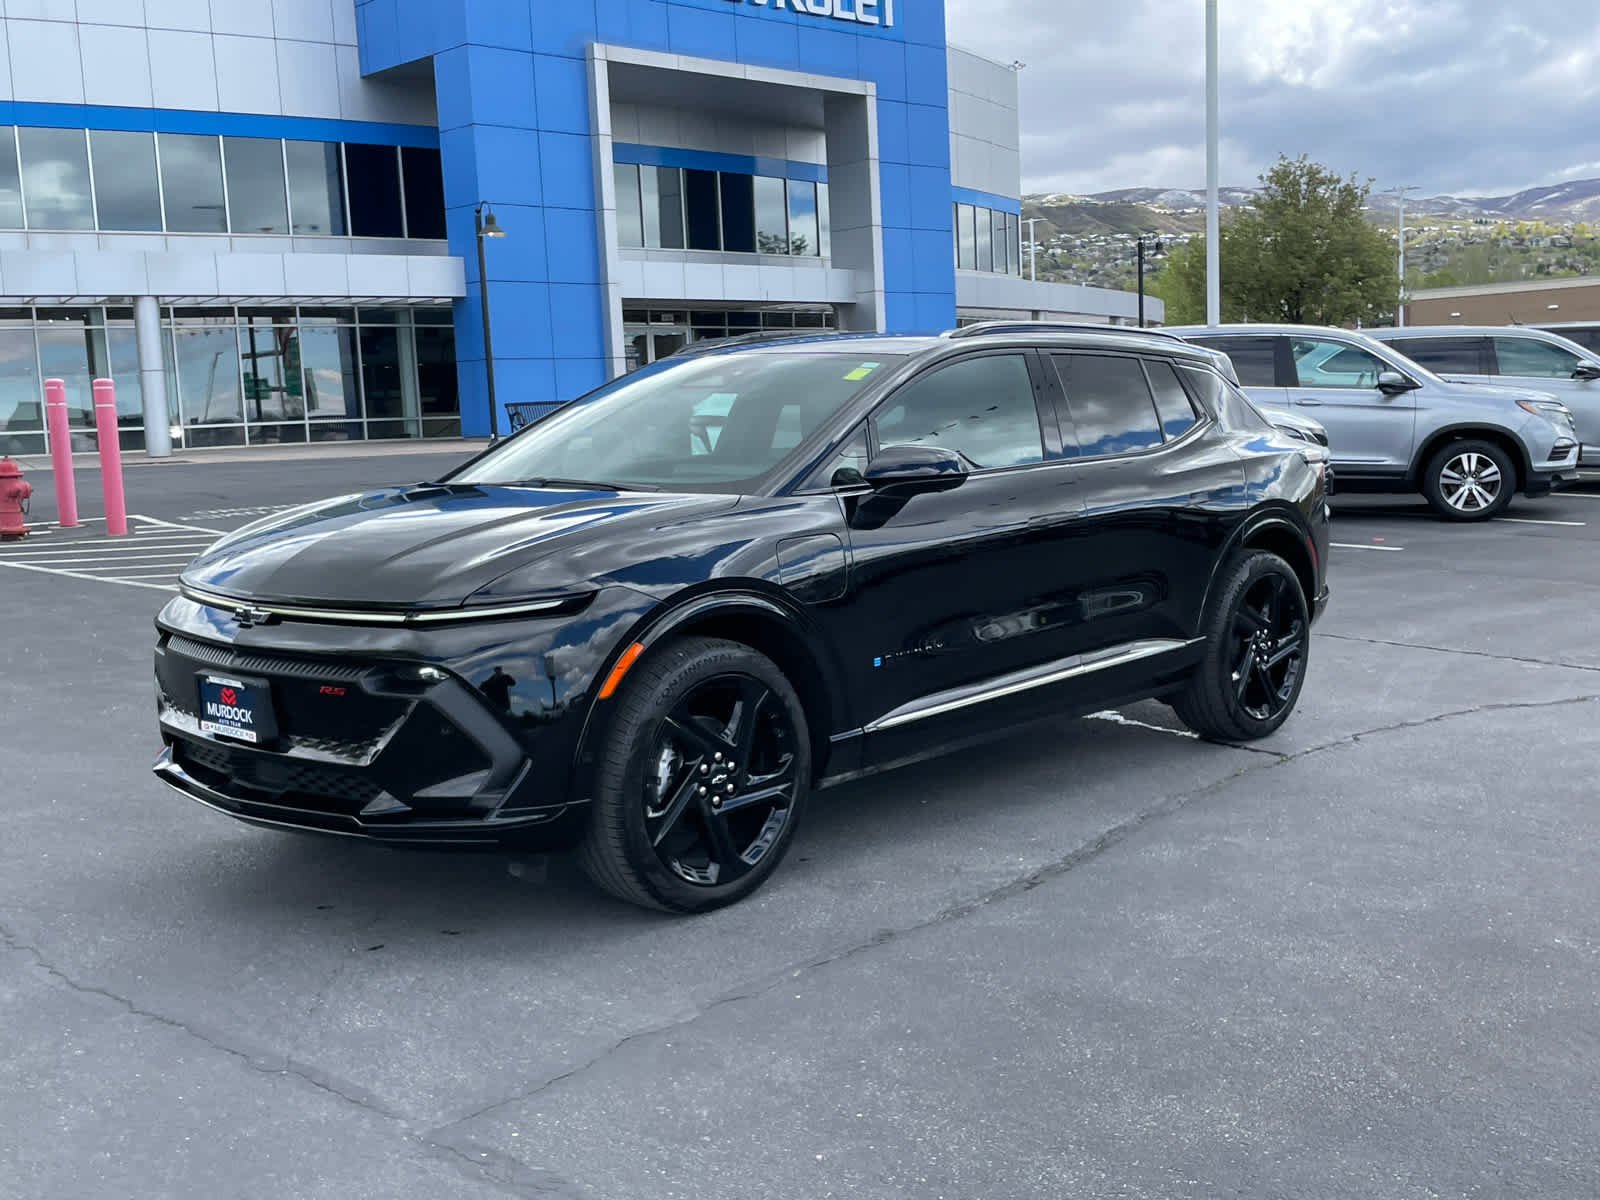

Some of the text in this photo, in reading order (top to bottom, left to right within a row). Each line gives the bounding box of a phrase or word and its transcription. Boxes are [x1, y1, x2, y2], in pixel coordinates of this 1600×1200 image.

[753, 0, 894, 27] LET
[207, 702, 253, 724] MURDOCK
[230, 720, 241, 728] TEAM
